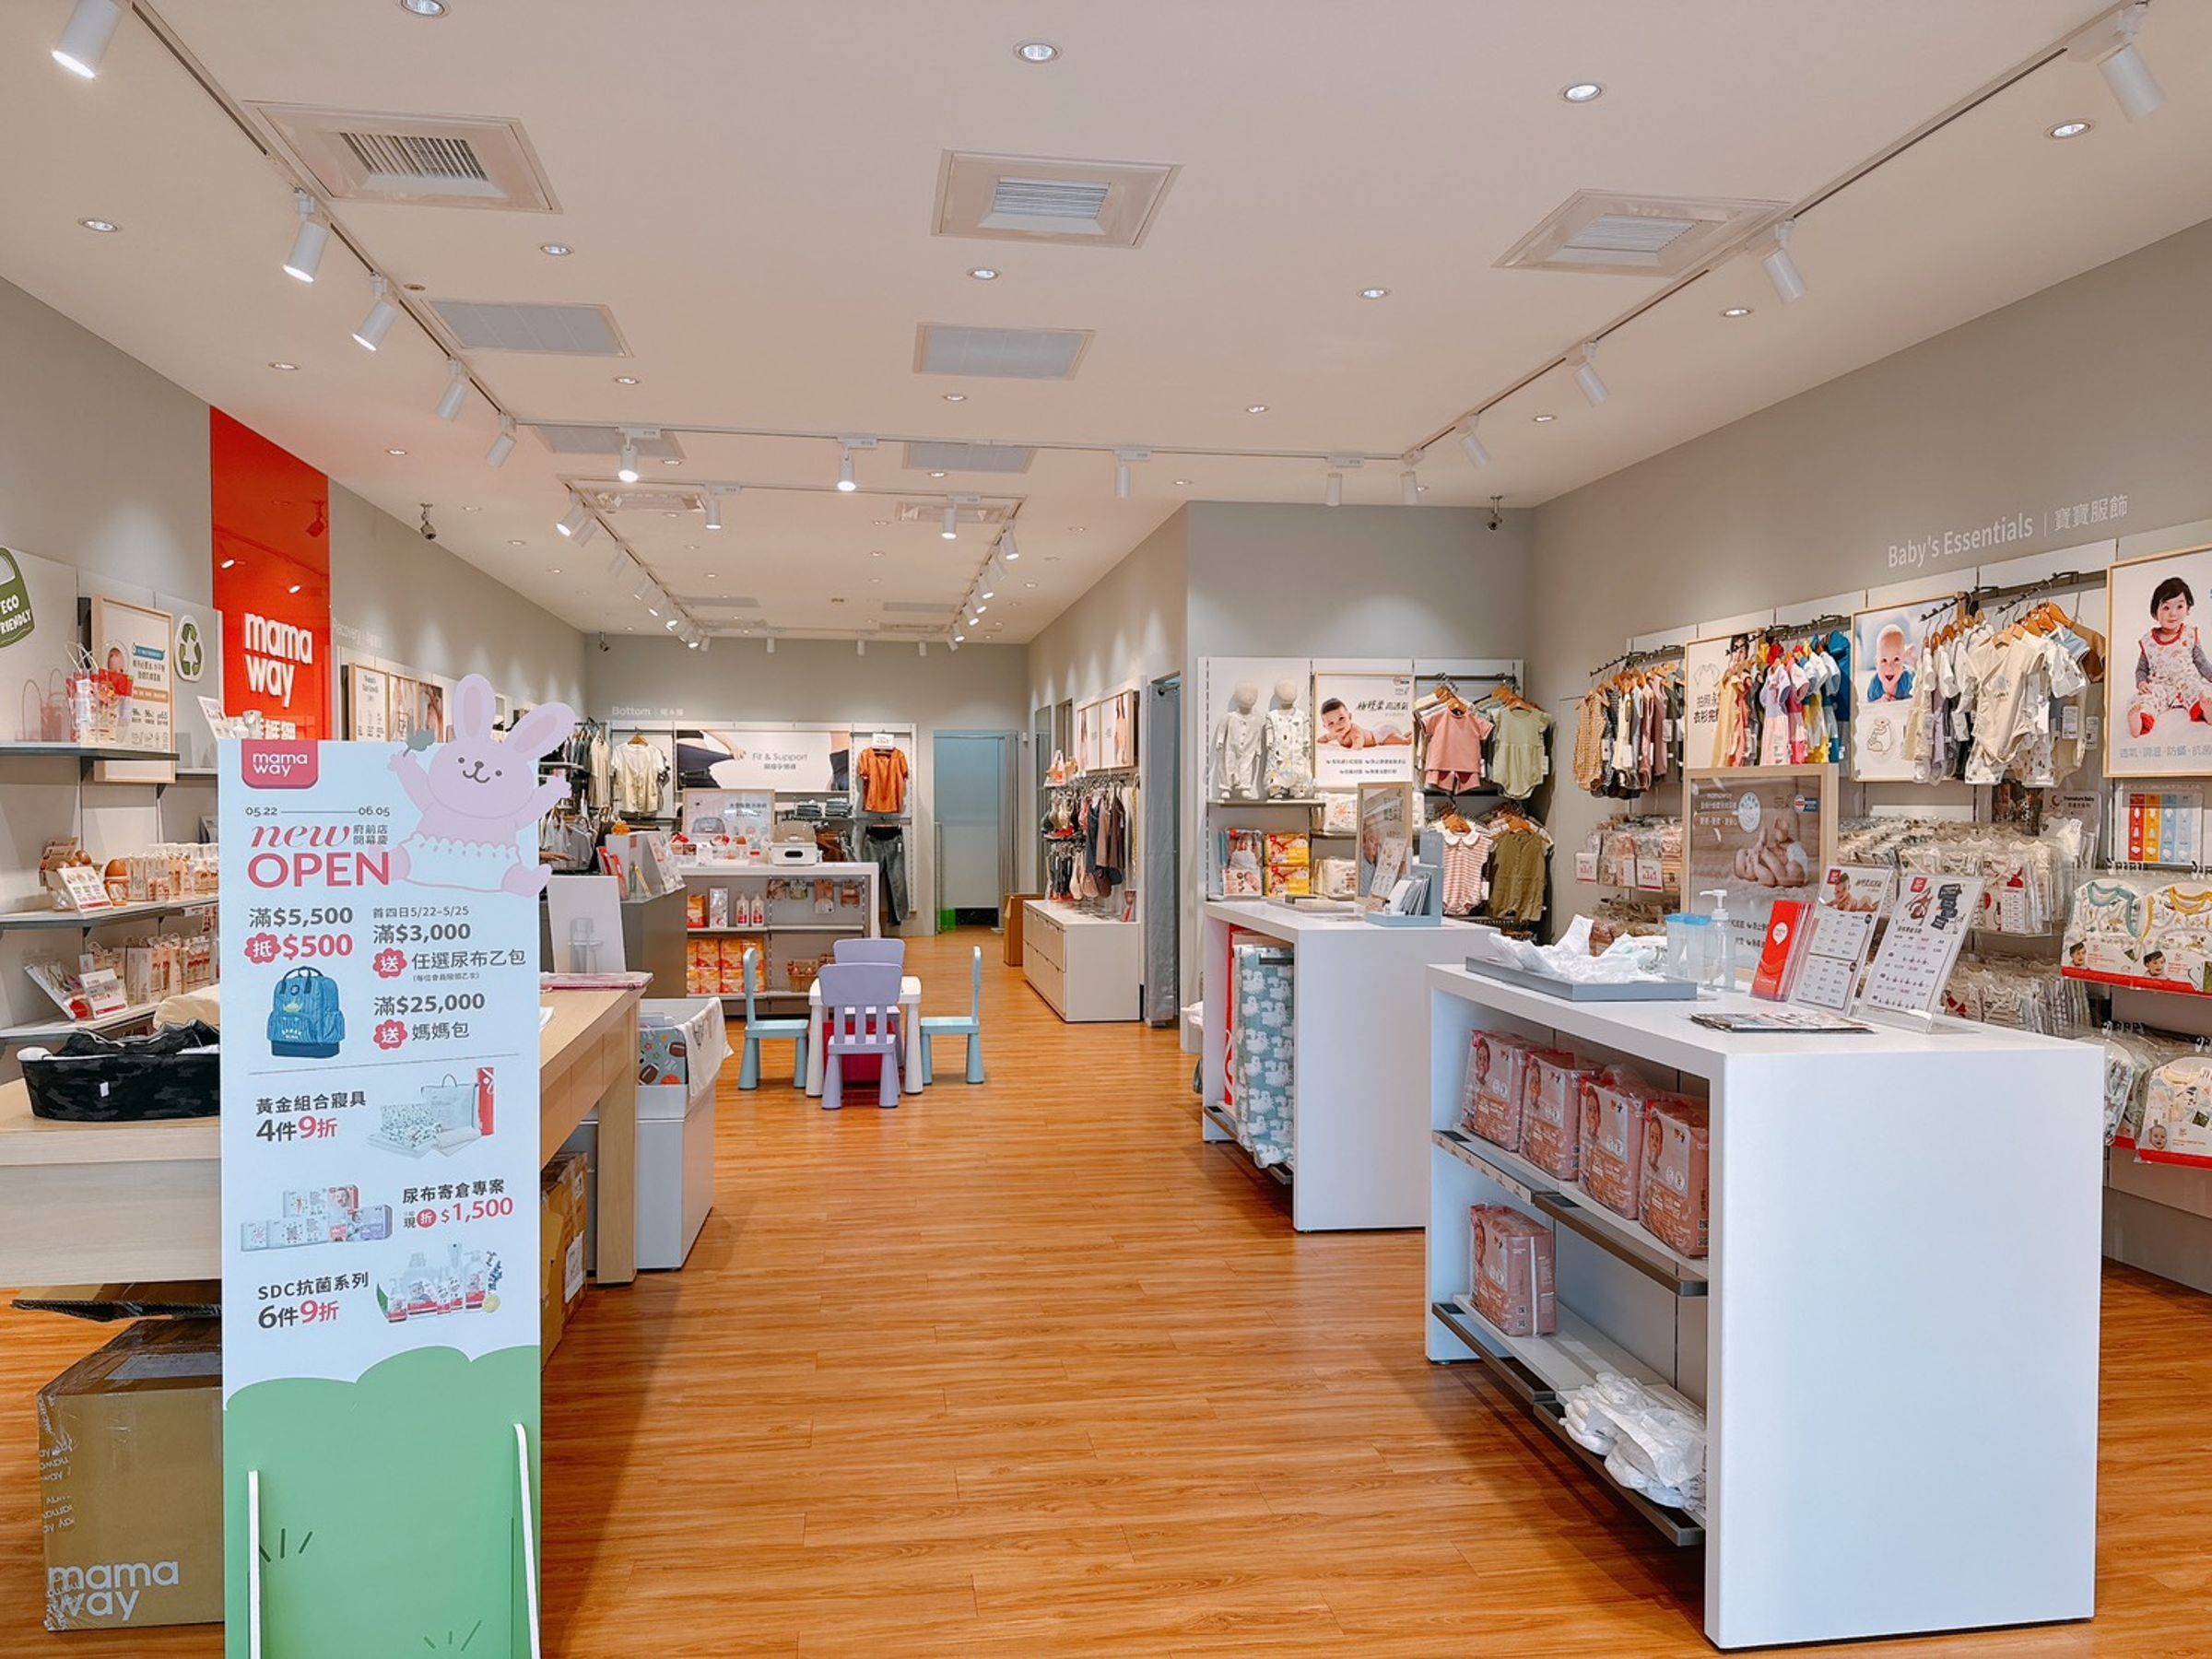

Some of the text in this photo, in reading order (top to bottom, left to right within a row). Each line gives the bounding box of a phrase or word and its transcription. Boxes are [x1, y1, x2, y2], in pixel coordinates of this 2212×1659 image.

[2053, 495, 2128, 532] 寶寶服飾
[1888, 512, 2033, 567] Baby's Essentials
[1, 594, 19, 615] ECO
[0, 609, 31, 635] RIENDLY
[244, 613, 312, 665] mama
[245, 654, 295, 708] way
[612, 706, 651, 715] Bottom
[253, 753, 308, 765] mama
[774, 752, 808, 763] Support
[253, 764, 291, 778] way
[245, 806, 391, 817] 05.22 06.05
[251, 823, 350, 848] new
[247, 851, 390, 888] OPEN
[249, 907, 353, 927] 滿$5,500
[373, 923, 471, 945] 滿$3,000
[282, 934, 353, 960] $500
[381, 949, 525, 973] 送 任選尿布乙包
[374, 993, 486, 1016] 滿$25,000
[381, 1021, 469, 1045] 送 媽媽包
[255, 1090, 367, 1115] 黃金組合寢具
[255, 1115, 337, 1142] 4件9折
[403, 1179, 505, 1204] 尿布寄倉專案
[441, 1197, 513, 1223] $1,500
[258, 1272, 369, 1300] SDC抗菌系列
[258, 1300, 338, 1328] 6件9折
[48, 1560, 179, 1590] mama
